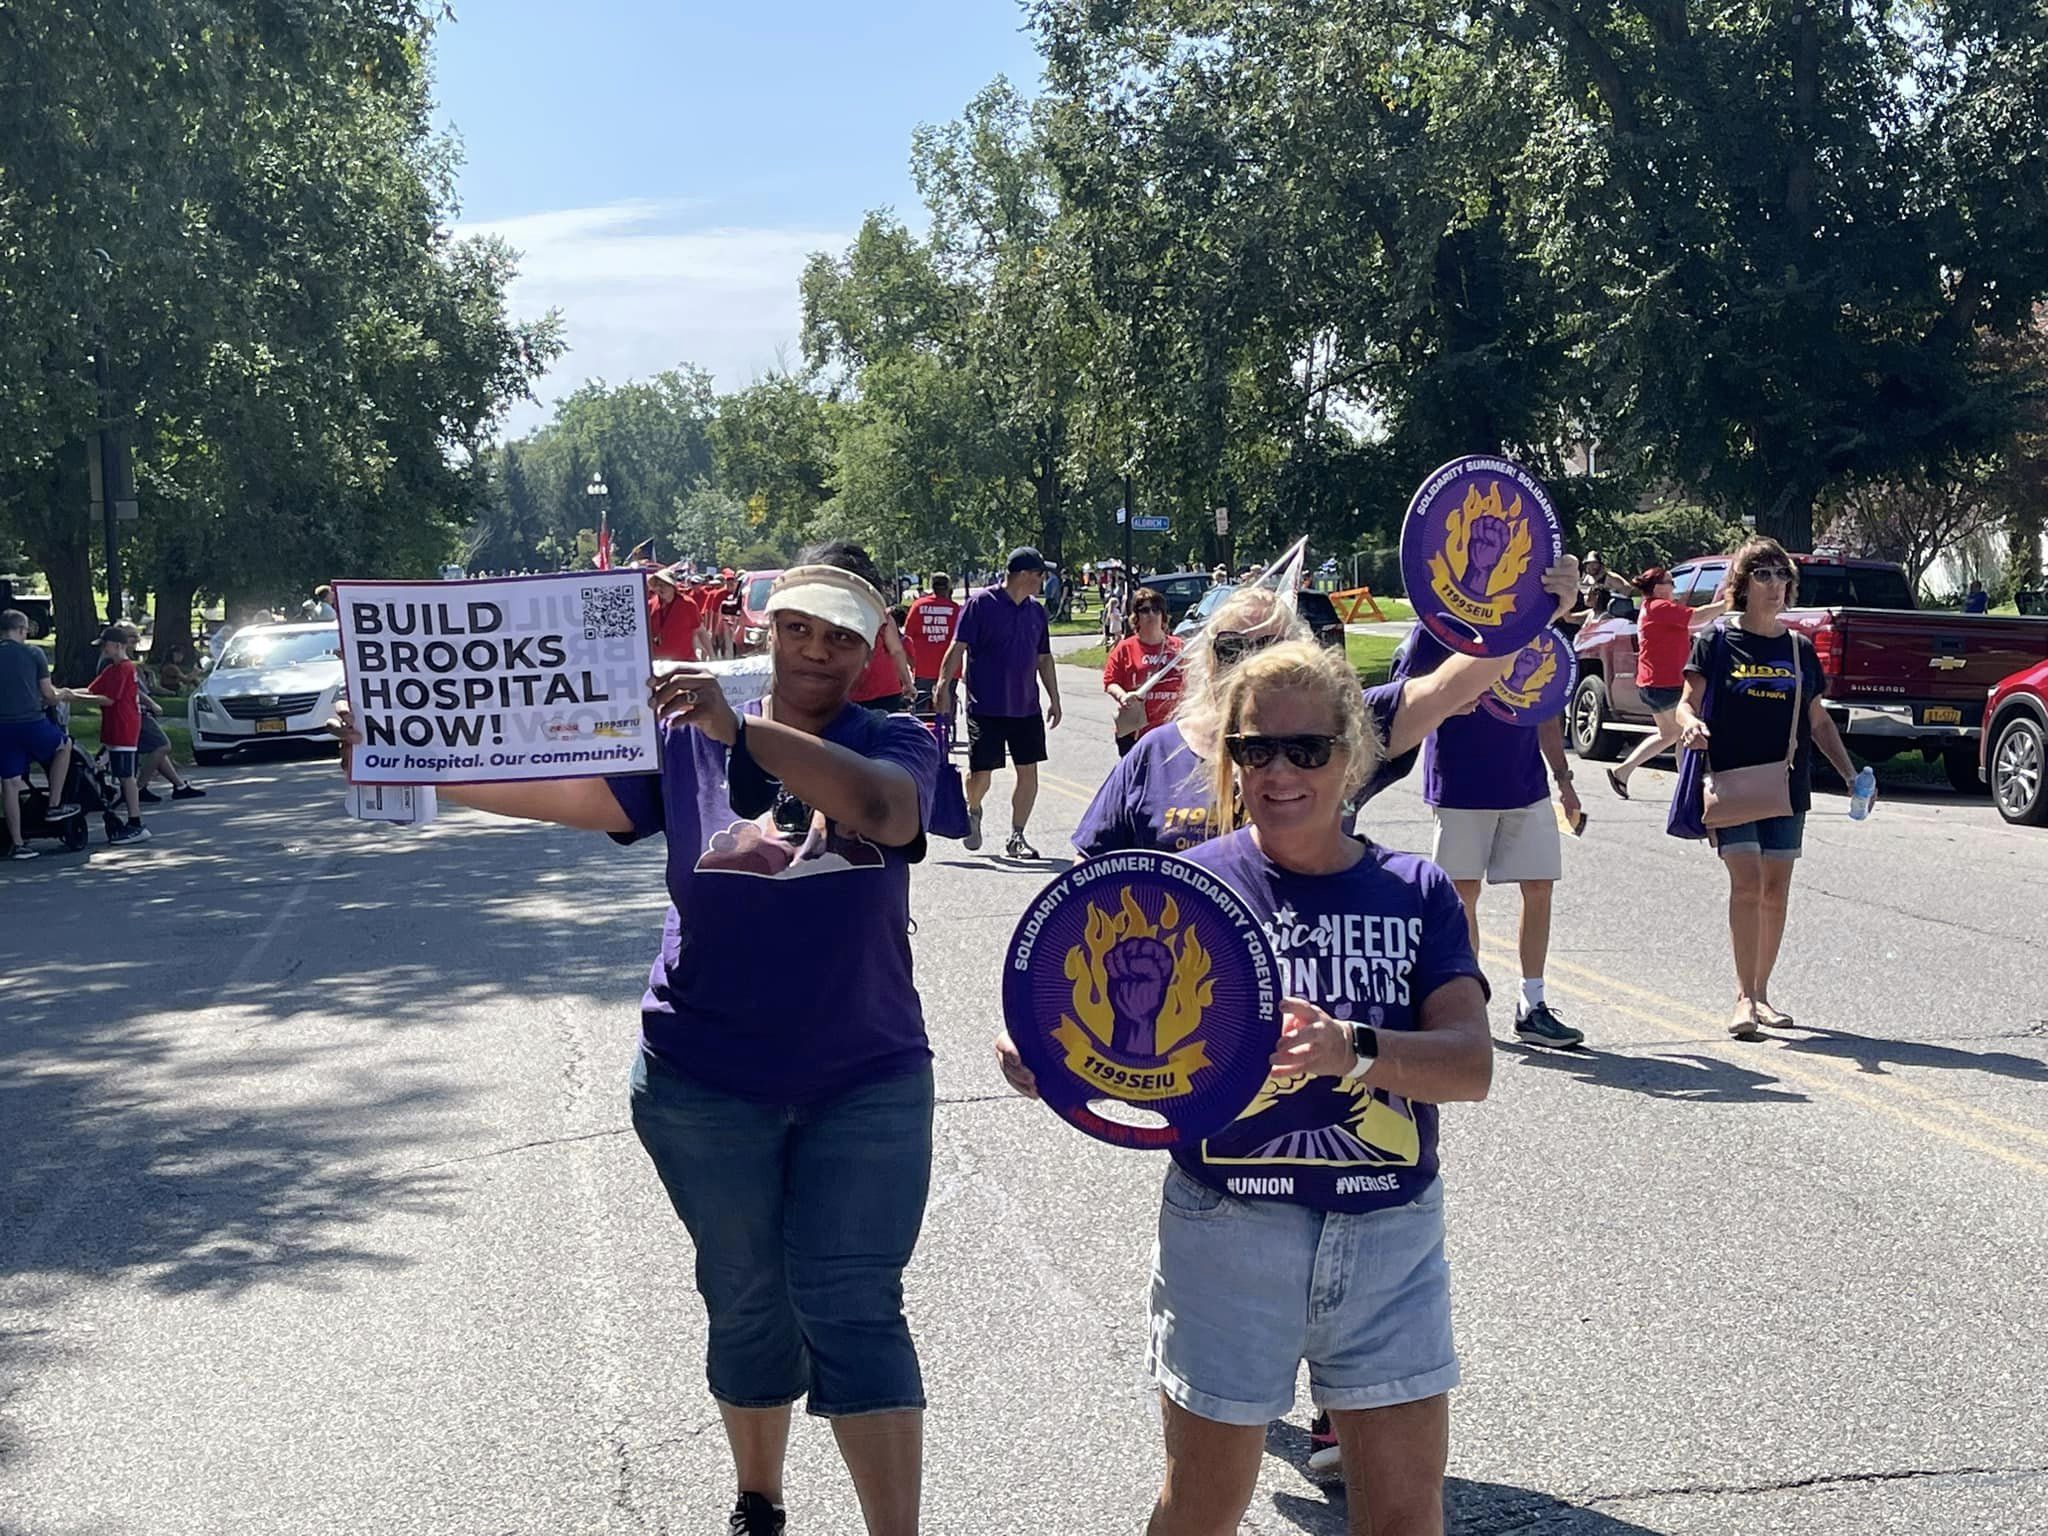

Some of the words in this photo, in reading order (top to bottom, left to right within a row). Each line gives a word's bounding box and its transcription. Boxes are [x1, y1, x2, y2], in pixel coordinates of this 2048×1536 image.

[1417, 464, 1464, 516] SOLIDARITY
[1465, 459, 1517, 478] SUMMER!
[1517, 472, 1558, 530] SOLIDARITY
[352, 601, 503, 635] BUILD
[1441, 583, 1494, 619] 1199SEIU
[356, 635, 567, 673] BROOKS
[361, 671, 609, 710] HOSPITAL
[364, 714, 503, 748] NOW!
[365, 754, 400, 769] Our
[404, 752, 484, 773] hospital.
[490, 753, 523, 767] Our
[530, 744, 645, 765] community.
[1014, 879, 1071, 972] SOLIDARITY
[1072, 855, 1155, 888] SUMMER!
[1160, 860, 1249, 928] SOLIDARITY
[1243, 930, 1274, 1022] FOREVER!
[1318, 914, 1423, 964] NEEDS
[1326, 957, 1413, 1007] JOBS
[1083, 1055, 1175, 1090] 1199SEIU
[1226, 1176, 1295, 1196] #UNION
[1335, 1172, 1401, 1195] #WERISE
